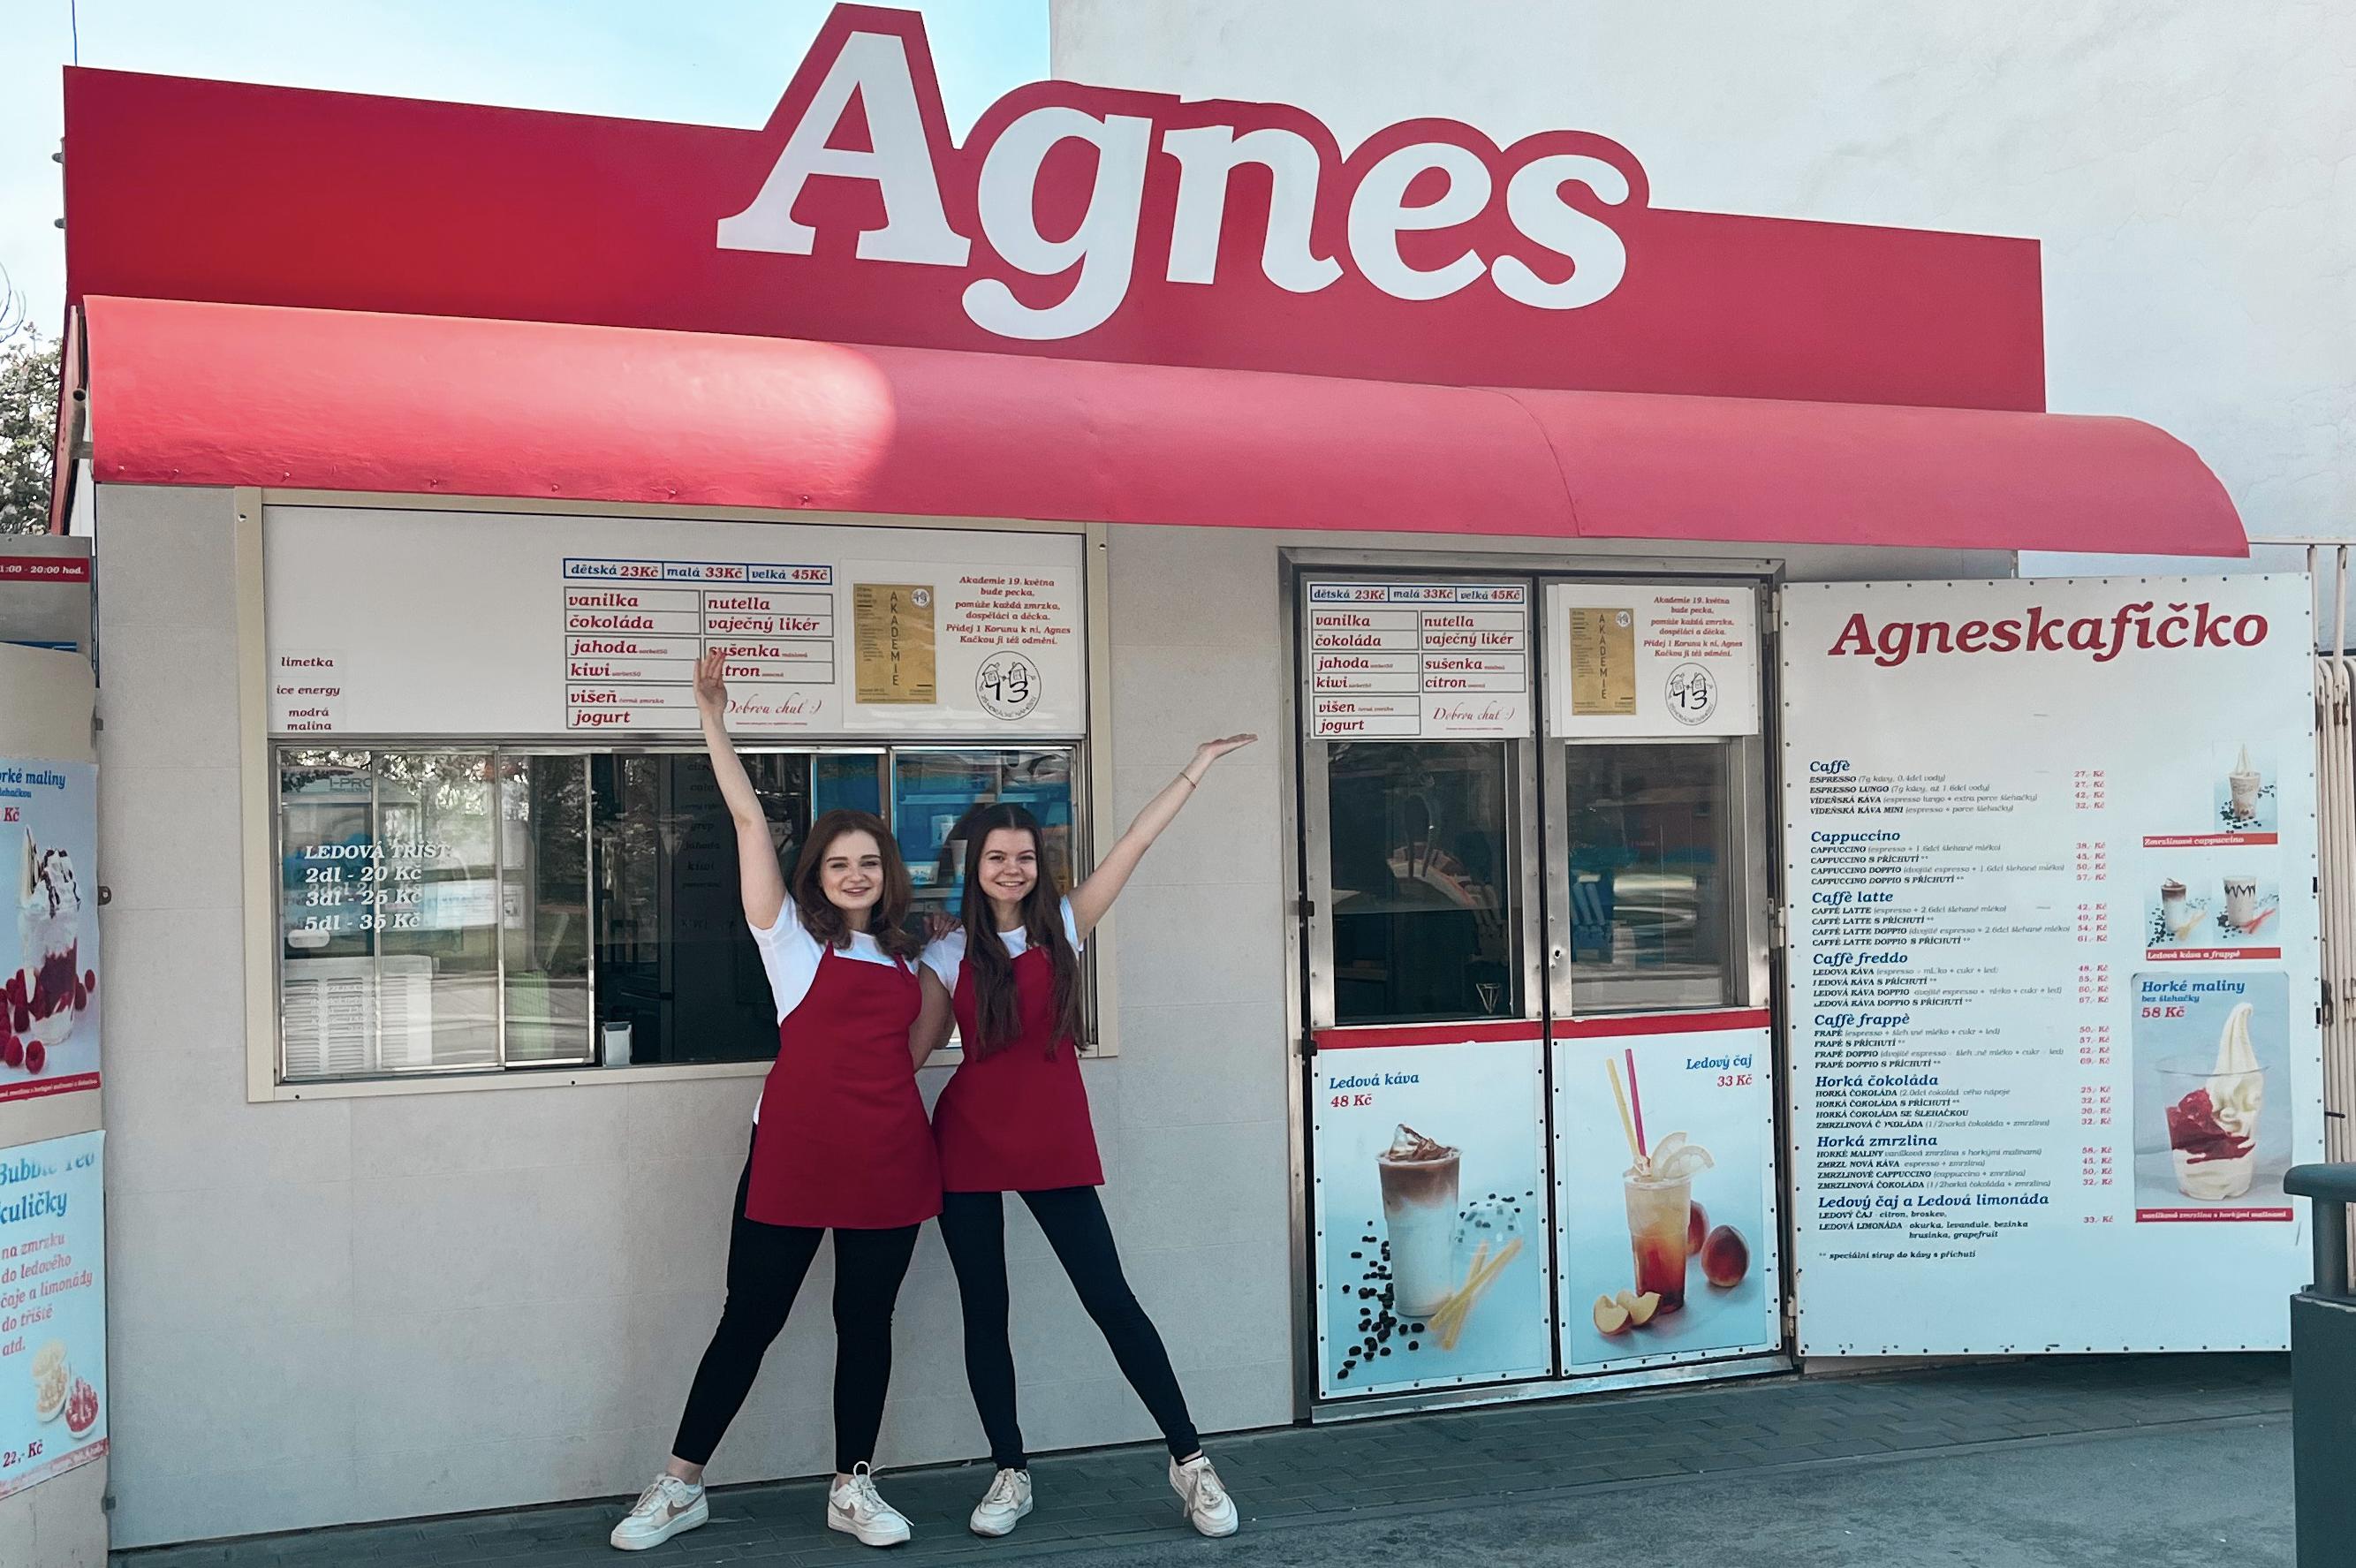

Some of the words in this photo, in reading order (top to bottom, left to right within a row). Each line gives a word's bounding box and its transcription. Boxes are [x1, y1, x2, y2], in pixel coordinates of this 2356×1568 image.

[716, 30, 1630, 340] Agnes
[571, 564, 617, 575] dětská
[620, 565, 658, 578] 23Kč
[667, 567, 701, 577] malá
[705, 567, 743, 579] 33Kč
[752, 569, 786, 579] velká
[792, 569, 828, 580] 45Kč
[569, 594, 639, 607] vanilka
[1314, 589, 1350, 599] dětská
[1354, 590, 1385, 600] 23Kč
[1393, 590, 1420, 599] malá
[1423, 589, 1453, 599] 33Kč
[1460, 592, 1489, 601] velká
[1490, 590, 1519, 600] 45Kč
[708, 596, 770, 610] nutella
[570, 614, 654, 629] čokoláda
[966, 611, 1009, 620] dospěláci
[1315, 615, 1370, 627] vanilka
[1424, 616, 1474, 627] nutella
[708, 617, 774, 633] vaječný
[779, 618, 820, 631] likér
[1044, 626, 1071, 635] Agnes
[890, 591, 900, 686] AKADEMIE
[1315, 633, 1382, 647] čokoláda
[1425, 632, 1476, 647] vaječný
[1481, 633, 1513, 644] likér
[1828, 601, 2269, 666] Agneskafíčko
[573, 639, 637, 655] jahoda
[282, 657, 334, 667] limetka
[1425, 657, 1482, 670] sušenka
[1599, 614, 1608, 700] AKADEMIE
[571, 663, 610, 677] kiwi
[1317, 657, 1369, 673] jahoda
[1316, 677, 1347, 688] kiwi
[1425, 677, 1466, 688] citron
[277, 686, 294, 694] ice
[298, 686, 340, 696] energy
[289, 708, 329, 716] modrá
[573, 709, 630, 726] jogurt
[287, 722, 332, 731] malina
[1319, 720, 1364, 733] jogurt
[26, 770, 66, 789] maliny
[4, 807, 19, 822] Kč
[1811, 829, 1901, 845] Cappuccino
[305, 841, 384, 859] LEDOVÁ
[306, 867, 342, 882] 2dl
[360, 867, 388, 882] 20
[394, 866, 422, 881] Kč
[306, 891, 341, 906] 3dl
[360, 890, 388, 905] 25
[395, 890, 423, 905] Kč
[1813, 891, 1852, 905] Caffè
[1858, 891, 1894, 903] latte
[305, 915, 341, 931] 5dl
[360, 914, 386, 929] 35
[393, 913, 420, 928] Kč
[1814, 952, 1853, 966] Caffè
[1855, 952, 1908, 966] freddo
[2142, 981, 2187, 992] Horké
[2193, 981, 2246, 994] maliny
[2142, 1007, 2161, 1018] 58
[2165, 1006, 2186, 1018] Kč
[1814, 1014, 1854, 1027] Caffè
[1686, 1055, 1730, 1070] Ledový
[1734, 1054, 1752, 1068] čaj
[1330, 1073, 1380, 1089] Ledová
[1385, 1072, 1419, 1085] káva
[1717, 1076, 1733, 1087] 33
[1737, 1074, 1753, 1086] Kč
[1815, 1075, 1863, 1087] Horká
[1868, 1074, 1938, 1087] čokoláda
[1331, 1095, 1348, 1107] 48
[1353, 1094, 1372, 1106] Kč
[1817, 1135, 1864, 1148] Horká
[1869, 1135, 1937, 1147] zmrzlina
[1819, 1195, 1871, 1209] Ledový
[1876, 1195, 1898, 1209] čaj
[1904, 1198, 1913, 1207] a
[1918, 1194, 1971, 1207] Ledová
[1976, 1193, 2049, 1206] limonáda
[1819, 1210, 1853, 1219] LEDOVÝ
[2, 1246, 18, 1260] na
[21, 1233, 64, 1254] zmrzku
[1829, 1252, 1869, 1261] speciální
[2, 1268, 17, 1284] do
[21, 1254, 72, 1279] ledového
[1, 1290, 26, 1308] čaje
[41, 1270, 93, 1297] limonády
[2, 1316, 17, 1332] do
[3, 1337, 26, 1356] atd.
[27, 1439, 43, 1458] Kč
